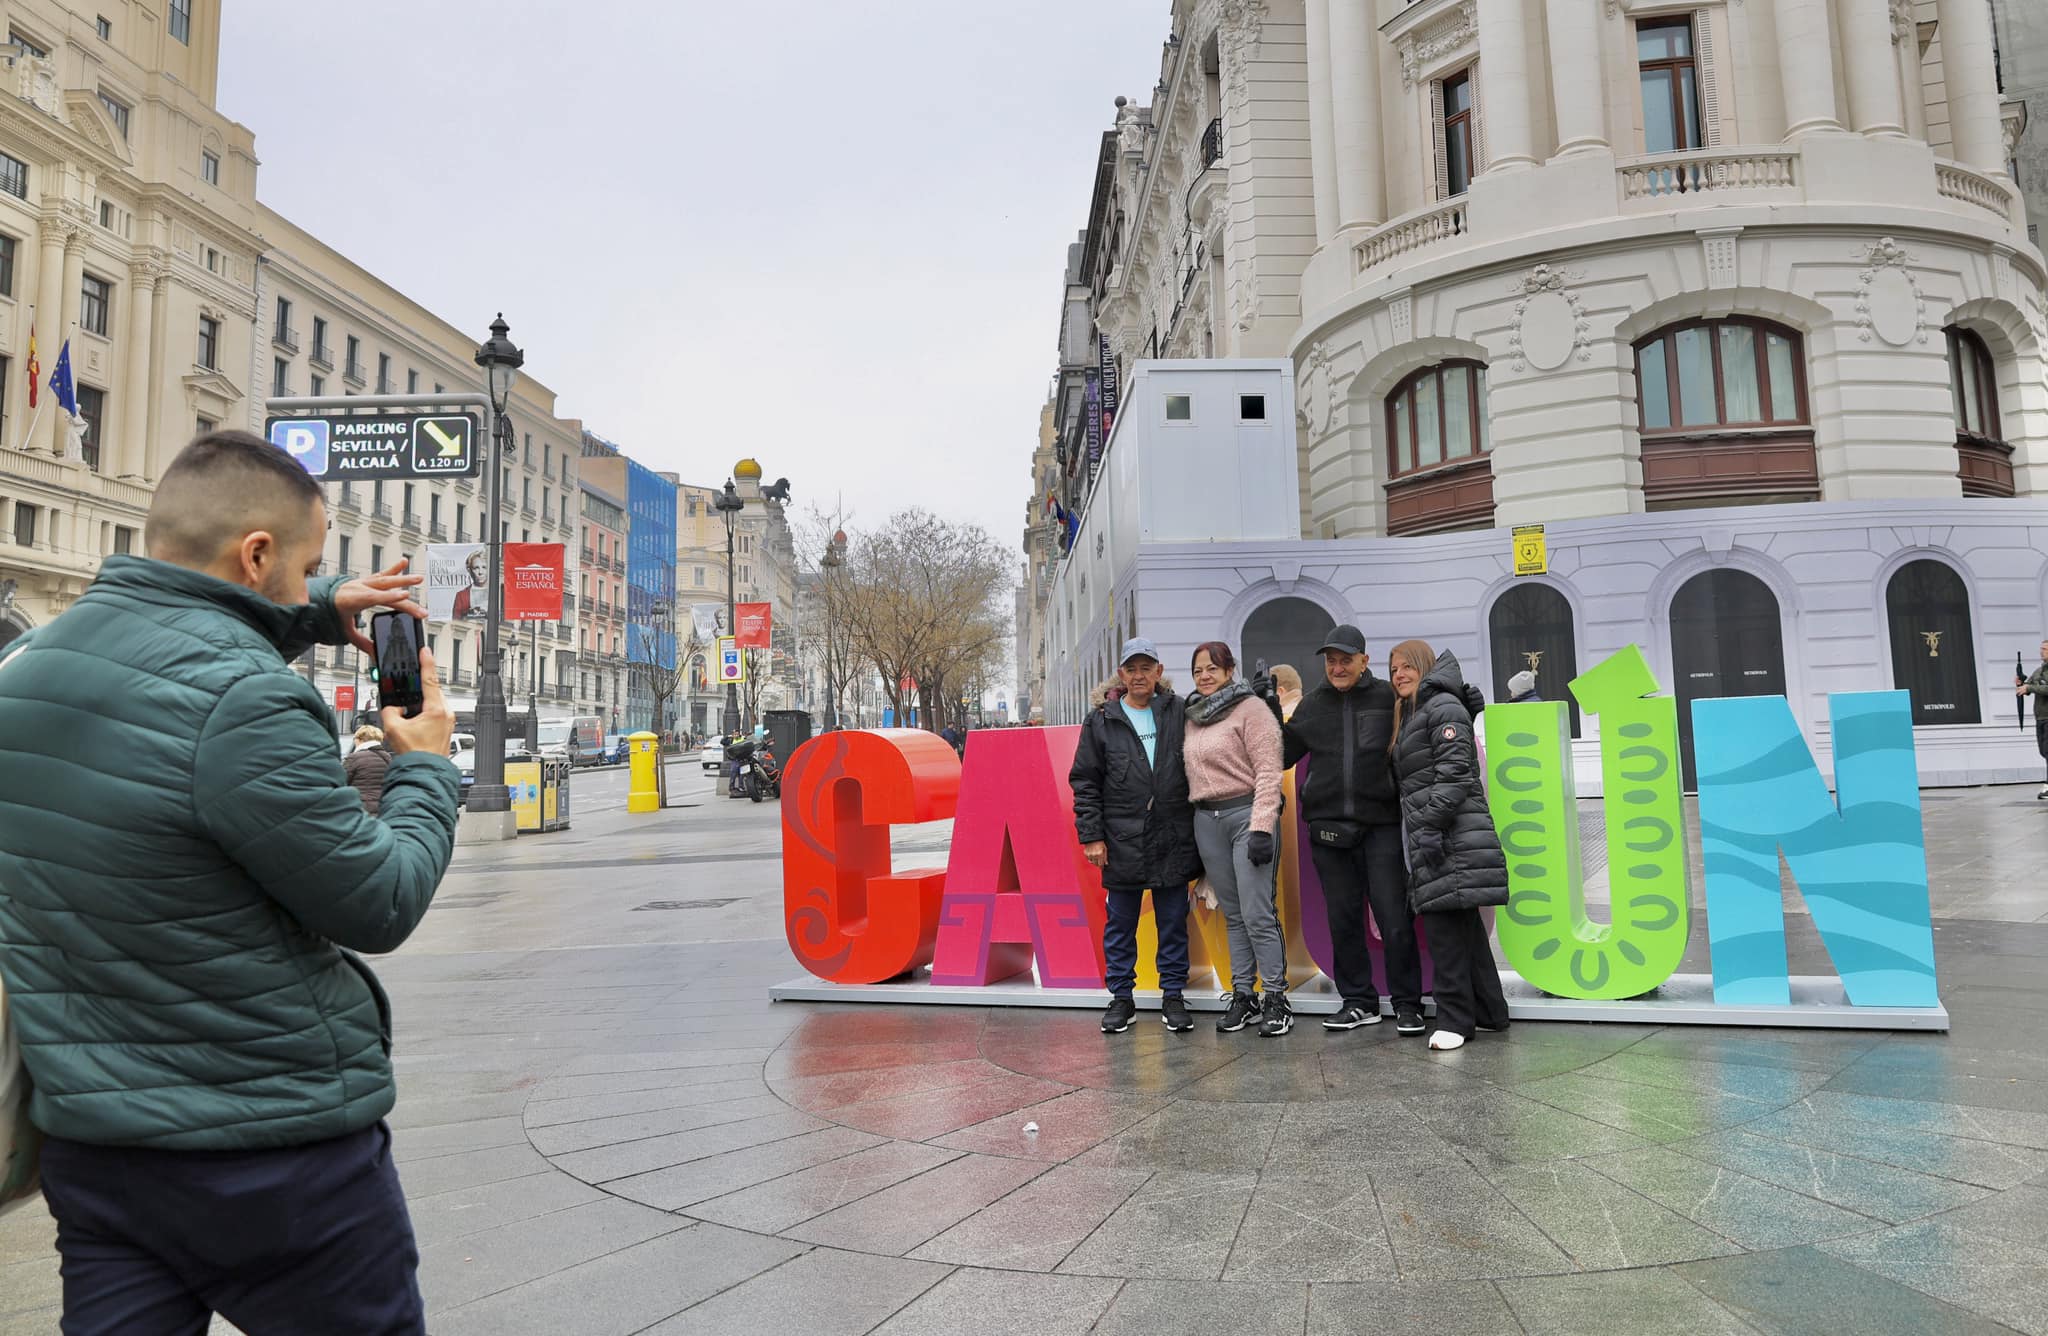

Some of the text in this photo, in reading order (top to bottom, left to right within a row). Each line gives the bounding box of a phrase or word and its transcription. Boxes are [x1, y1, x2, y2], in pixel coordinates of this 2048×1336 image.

[335, 423, 407, 435] PARKING
[1088, 403, 1100, 460] MUJERES
[331, 439, 409, 452] SEVILLA /
[339, 454, 400, 469] ALCALÁ
[418, 457, 465, 468] A 120 m
[515, 572, 554, 581] TEATRO
[516, 581, 559, 589] ESPAÑOL
